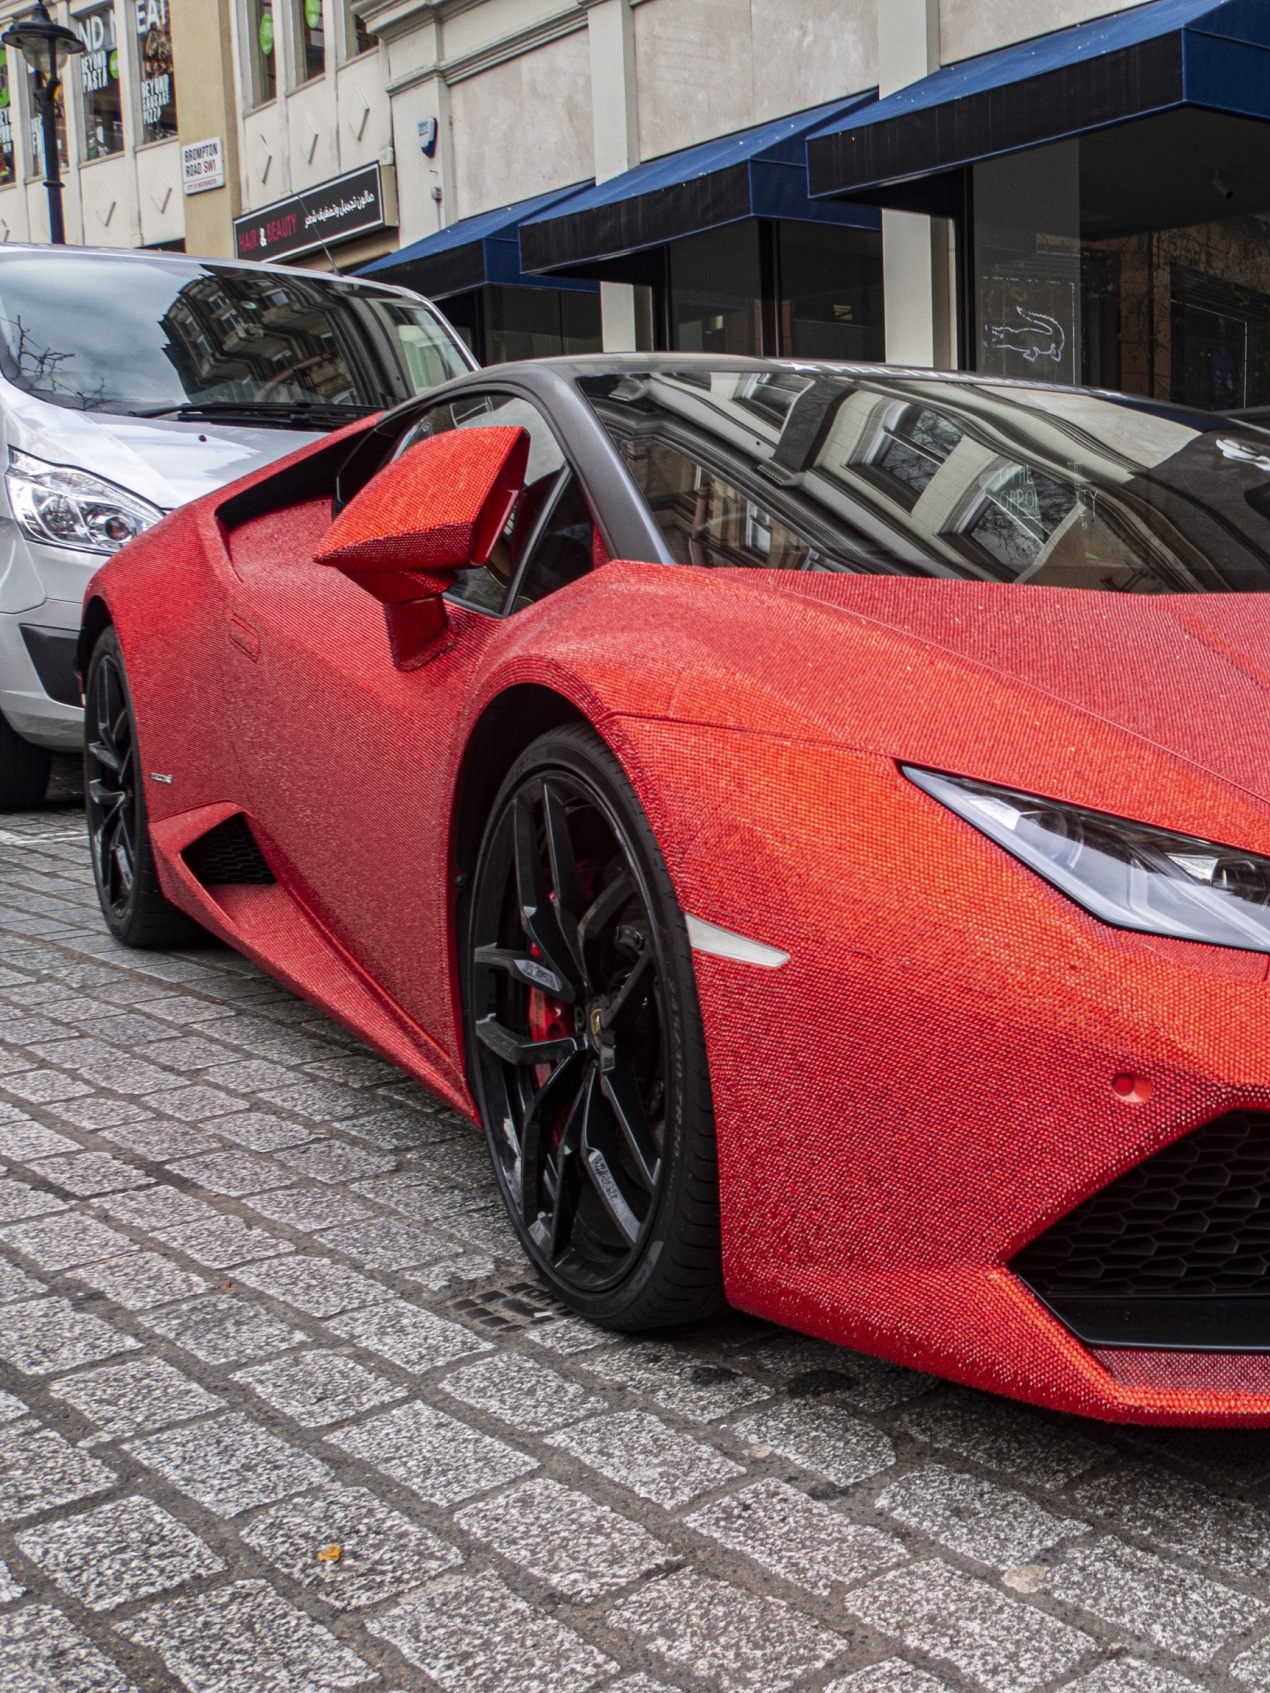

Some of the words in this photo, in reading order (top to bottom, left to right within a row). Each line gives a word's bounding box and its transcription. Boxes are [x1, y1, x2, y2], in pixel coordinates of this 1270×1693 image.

[82, 67, 109, 93] PASTA
[184, 142, 218, 163] BROMPTON
[185, 162, 202, 178] ROAD
[203, 159, 216, 174] SW1
[239, 230, 259, 253] HAIR
[259, 227, 268, 248] &
[266, 213, 297, 243] BEAUTY
